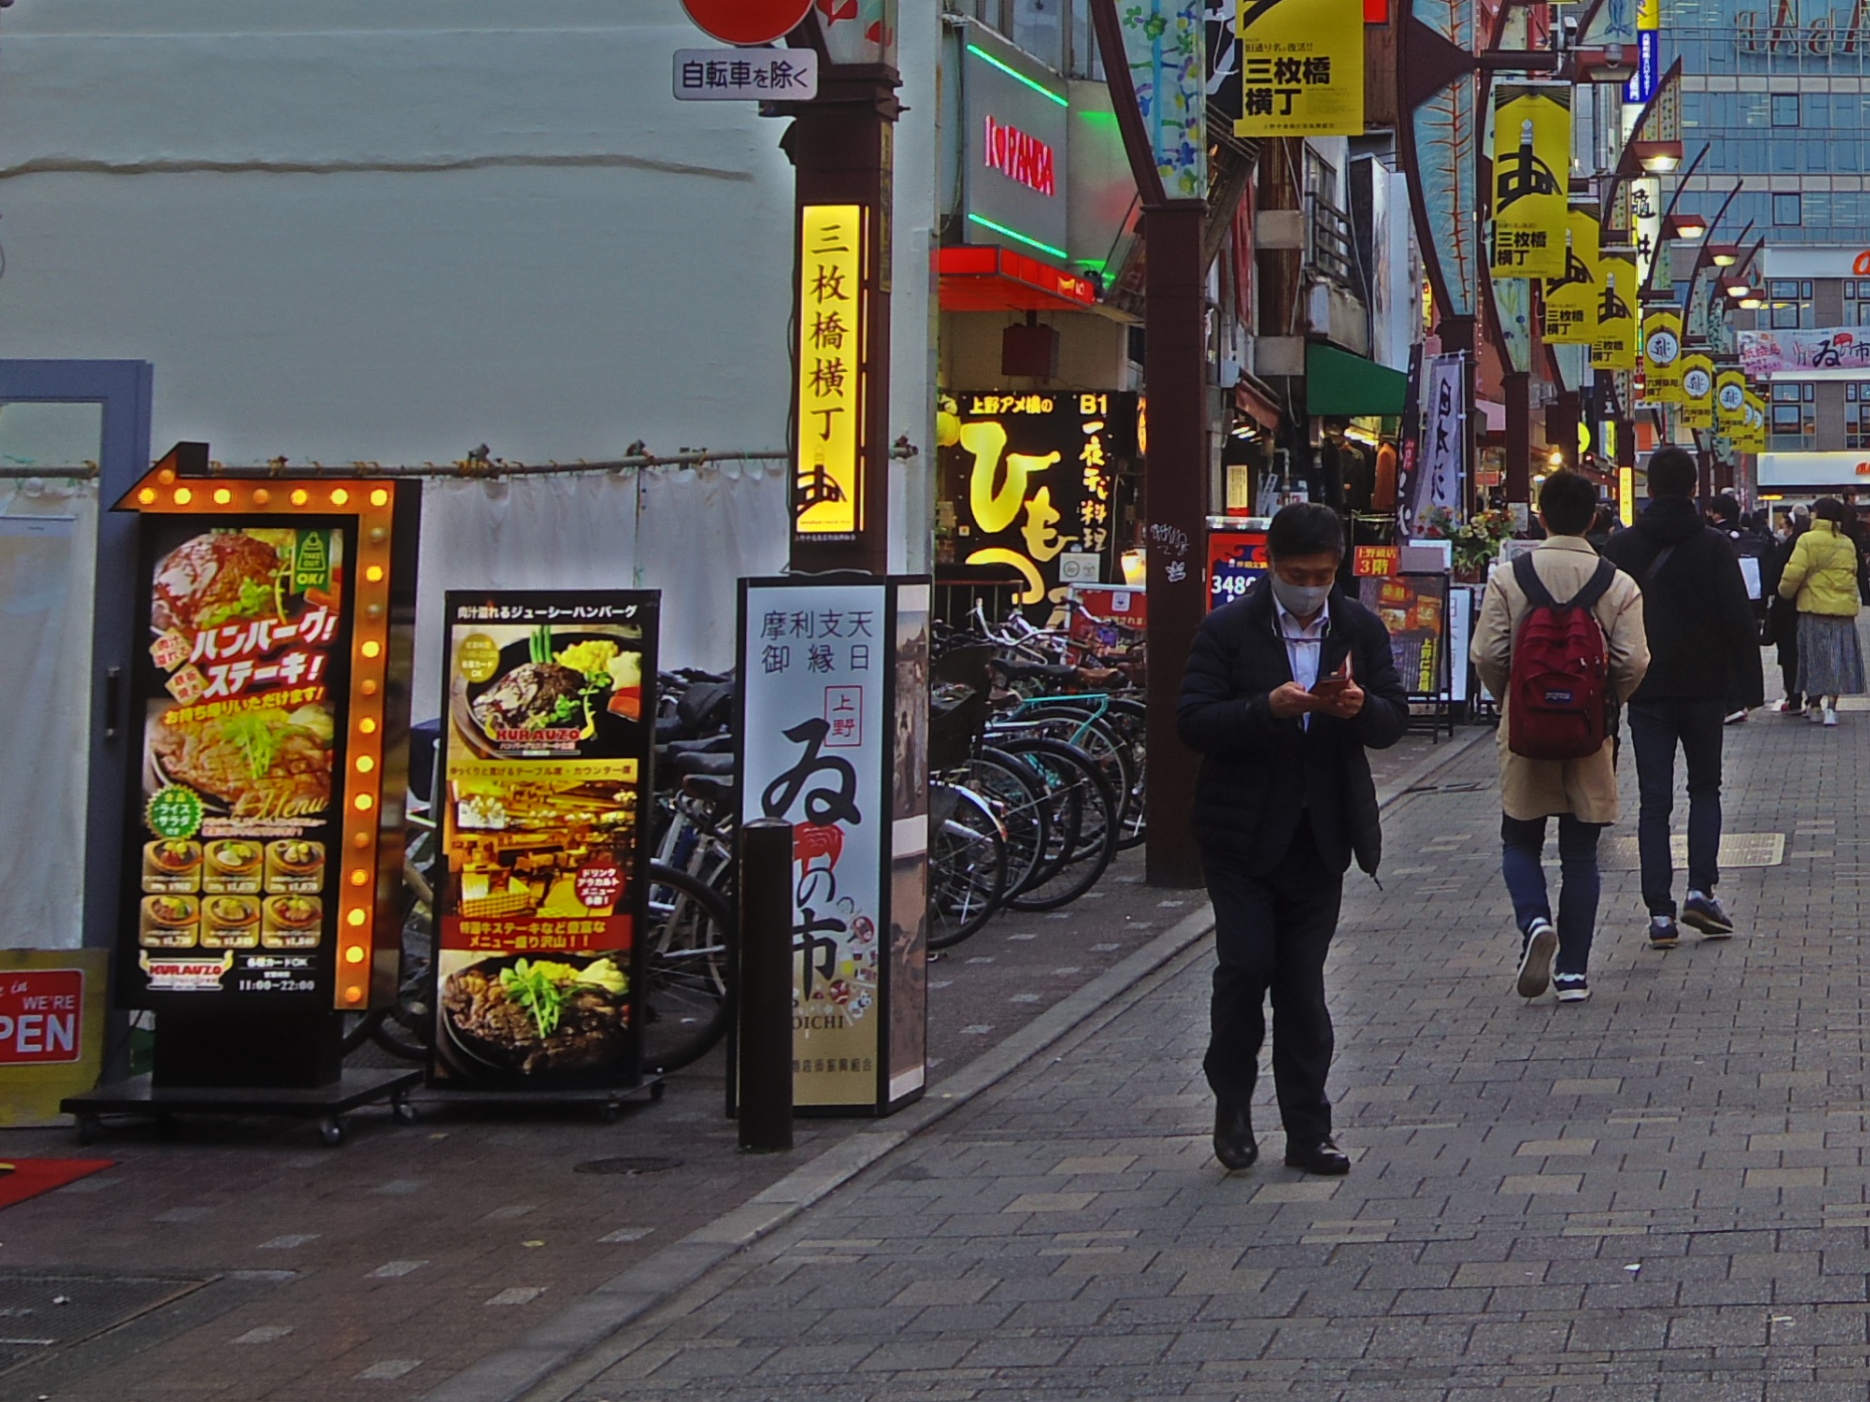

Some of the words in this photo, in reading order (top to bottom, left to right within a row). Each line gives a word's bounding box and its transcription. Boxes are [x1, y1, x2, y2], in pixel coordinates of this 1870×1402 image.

[682, 59, 809, 90] 自転車を除く
[1246, 56, 1331, 85] 三枚橋
[1245, 88, 1302, 116] 横丁
[1497, 231, 1547, 249] 三枚橋
[1497, 249, 1530, 267] 横丁
[1547, 309, 1584, 323] 三枚橋
[808, 223, 850, 442] 三枚橋横丁
[968, 394, 1054, 415] 上野アメ横の
[1079, 394, 1108, 415] B1
[1360, 560, 1390, 575] 3階
[189, 605, 338, 664] ハンバーグ!
[760, 609, 874, 641] 摩利支天
[761, 643, 871, 675] 御縁日
[202, 652, 325, 699] ステーキ!
[832, 693, 855, 738] 上野
[23, 994, 76, 1011] WE'RE
